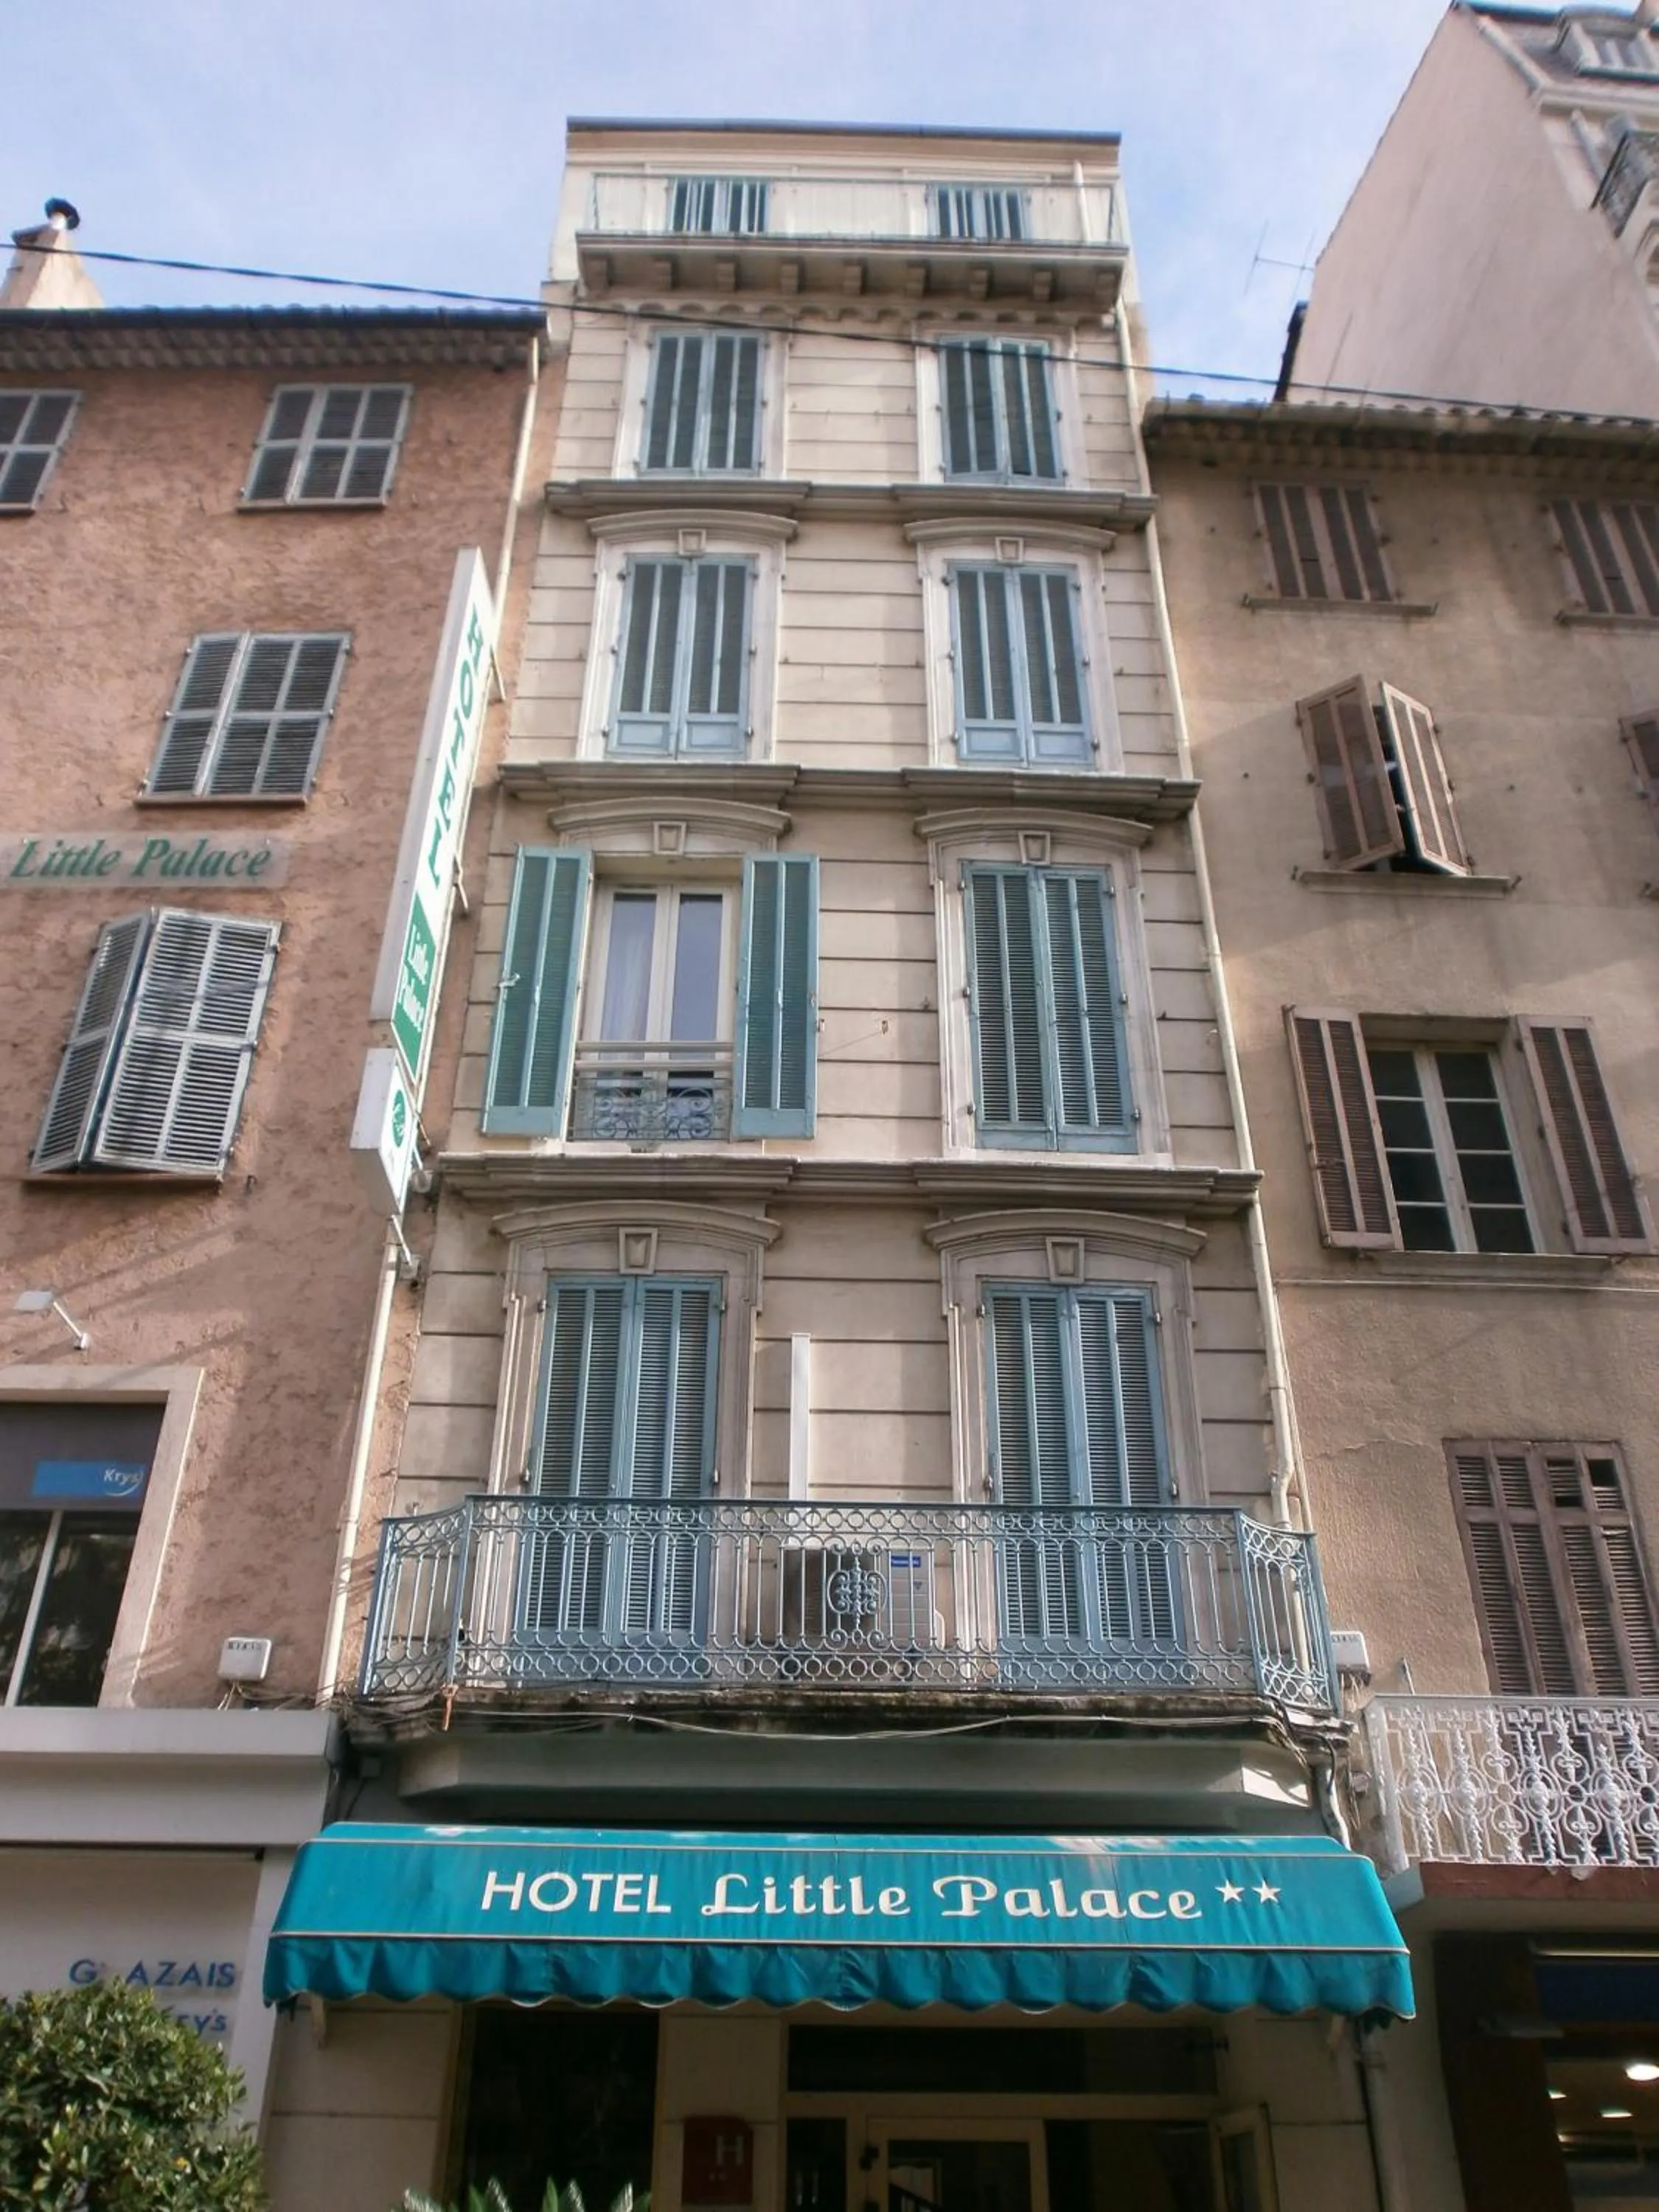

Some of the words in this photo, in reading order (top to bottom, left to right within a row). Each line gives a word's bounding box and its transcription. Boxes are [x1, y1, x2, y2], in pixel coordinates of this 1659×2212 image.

[428, 602, 484, 888] HOTEL
[10, 838, 122, 877] Little
[131, 837, 272, 877] Palace
[481, 1871, 672, 1913] HOTEL
[700, 1874, 911, 1916] Little
[932, 1875, 1203, 1919] Palace
[125, 1959, 236, 1988] AZAIS
[715, 2134, 745, 2166] H
